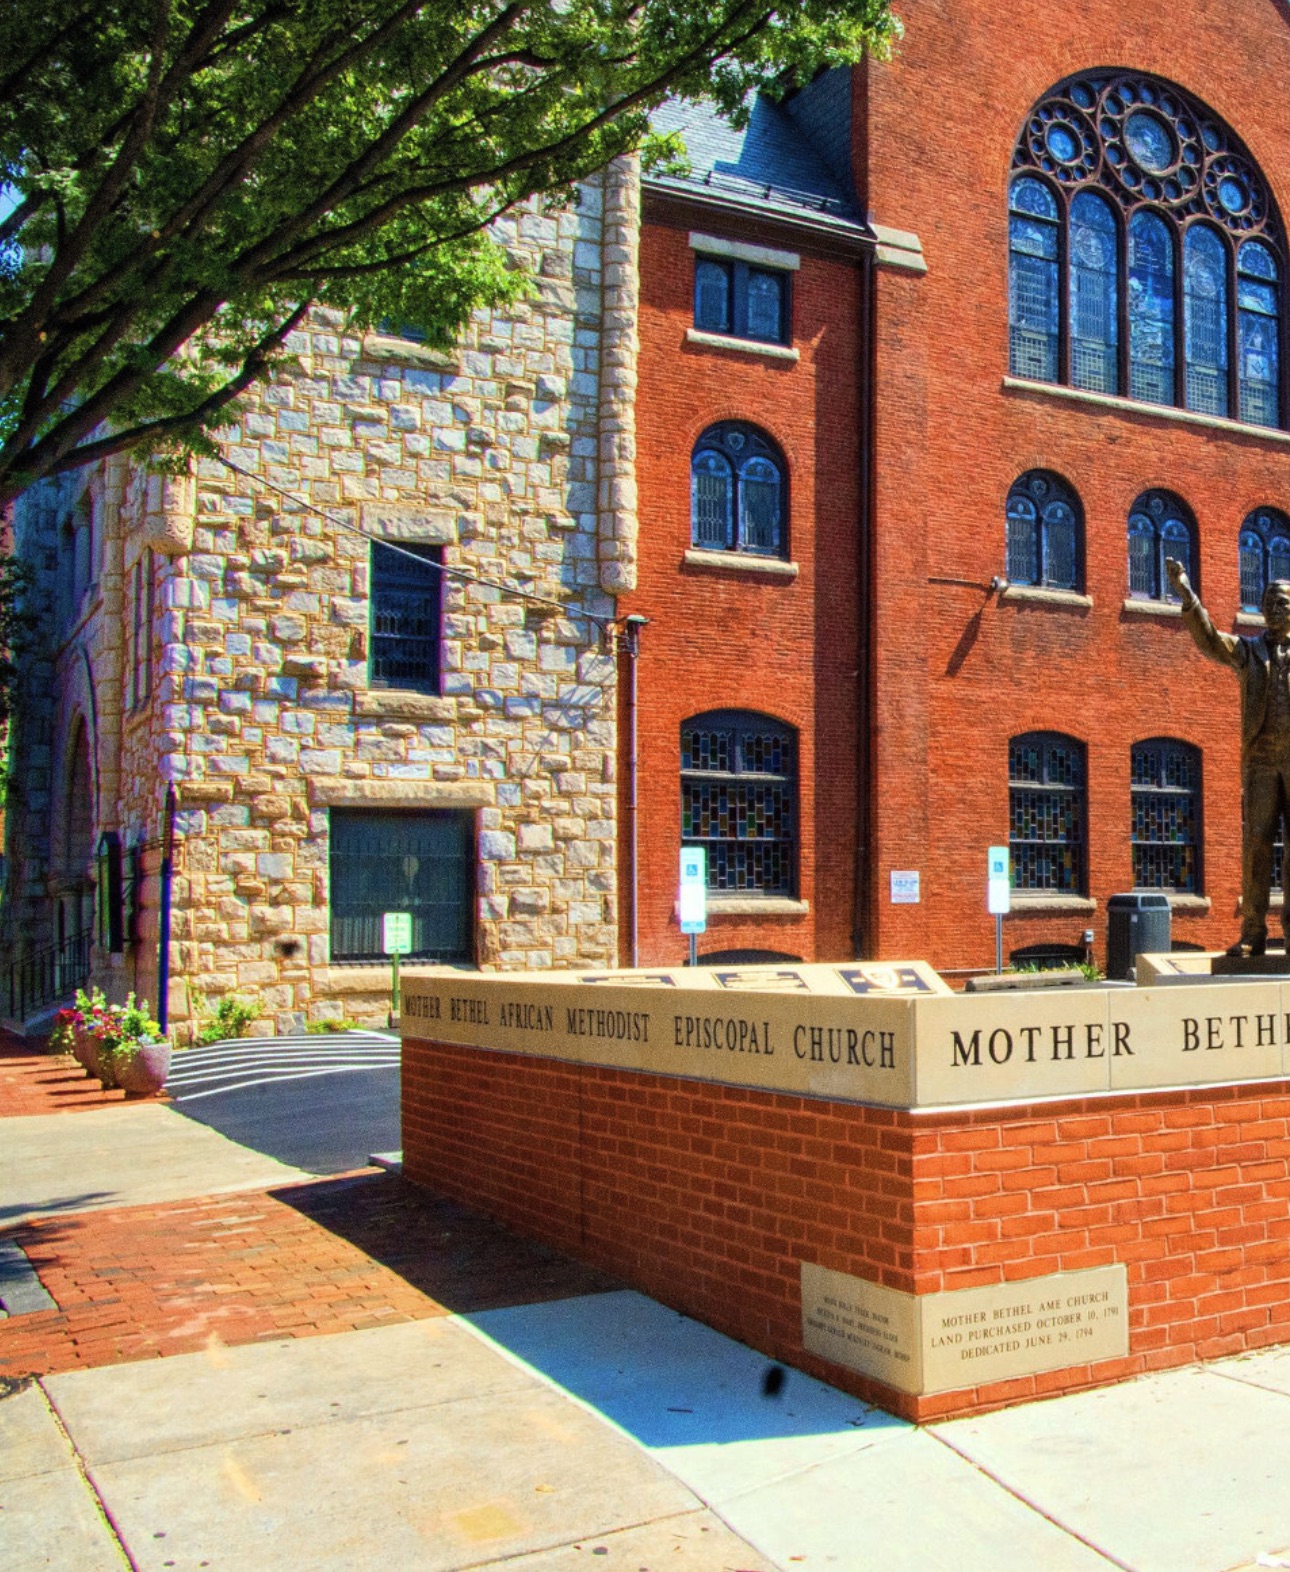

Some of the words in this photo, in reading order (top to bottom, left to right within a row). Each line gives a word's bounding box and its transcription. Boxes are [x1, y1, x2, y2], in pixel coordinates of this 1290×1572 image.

[404, 995, 442, 1019] MOTHER
[451, 997, 490, 1025] BETHEL
[500, 1002, 553, 1031] AFRICAN
[566, 1007, 650, 1042] METHODIST
[674, 1015, 774, 1055] EPISCOPAL
[793, 1024, 896, 1069] CHURCH
[949, 1020, 1136, 1068] MOTHER
[941, 1311, 987, 1329] MOTHER
[992, 1303, 1033, 1319] BETHEL
[1038, 1298, 1062, 1312] AME
[1066, 1290, 1109, 1308] CHURCH
[930, 1333, 963, 1348] LAND
[968, 1321, 1032, 1342] PURCHASED
[1036, 1312, 1082, 1329] OCTOBER
[960, 1341, 1020, 1360] DEDICATED
[1025, 1334, 1053, 1349] JUNE
